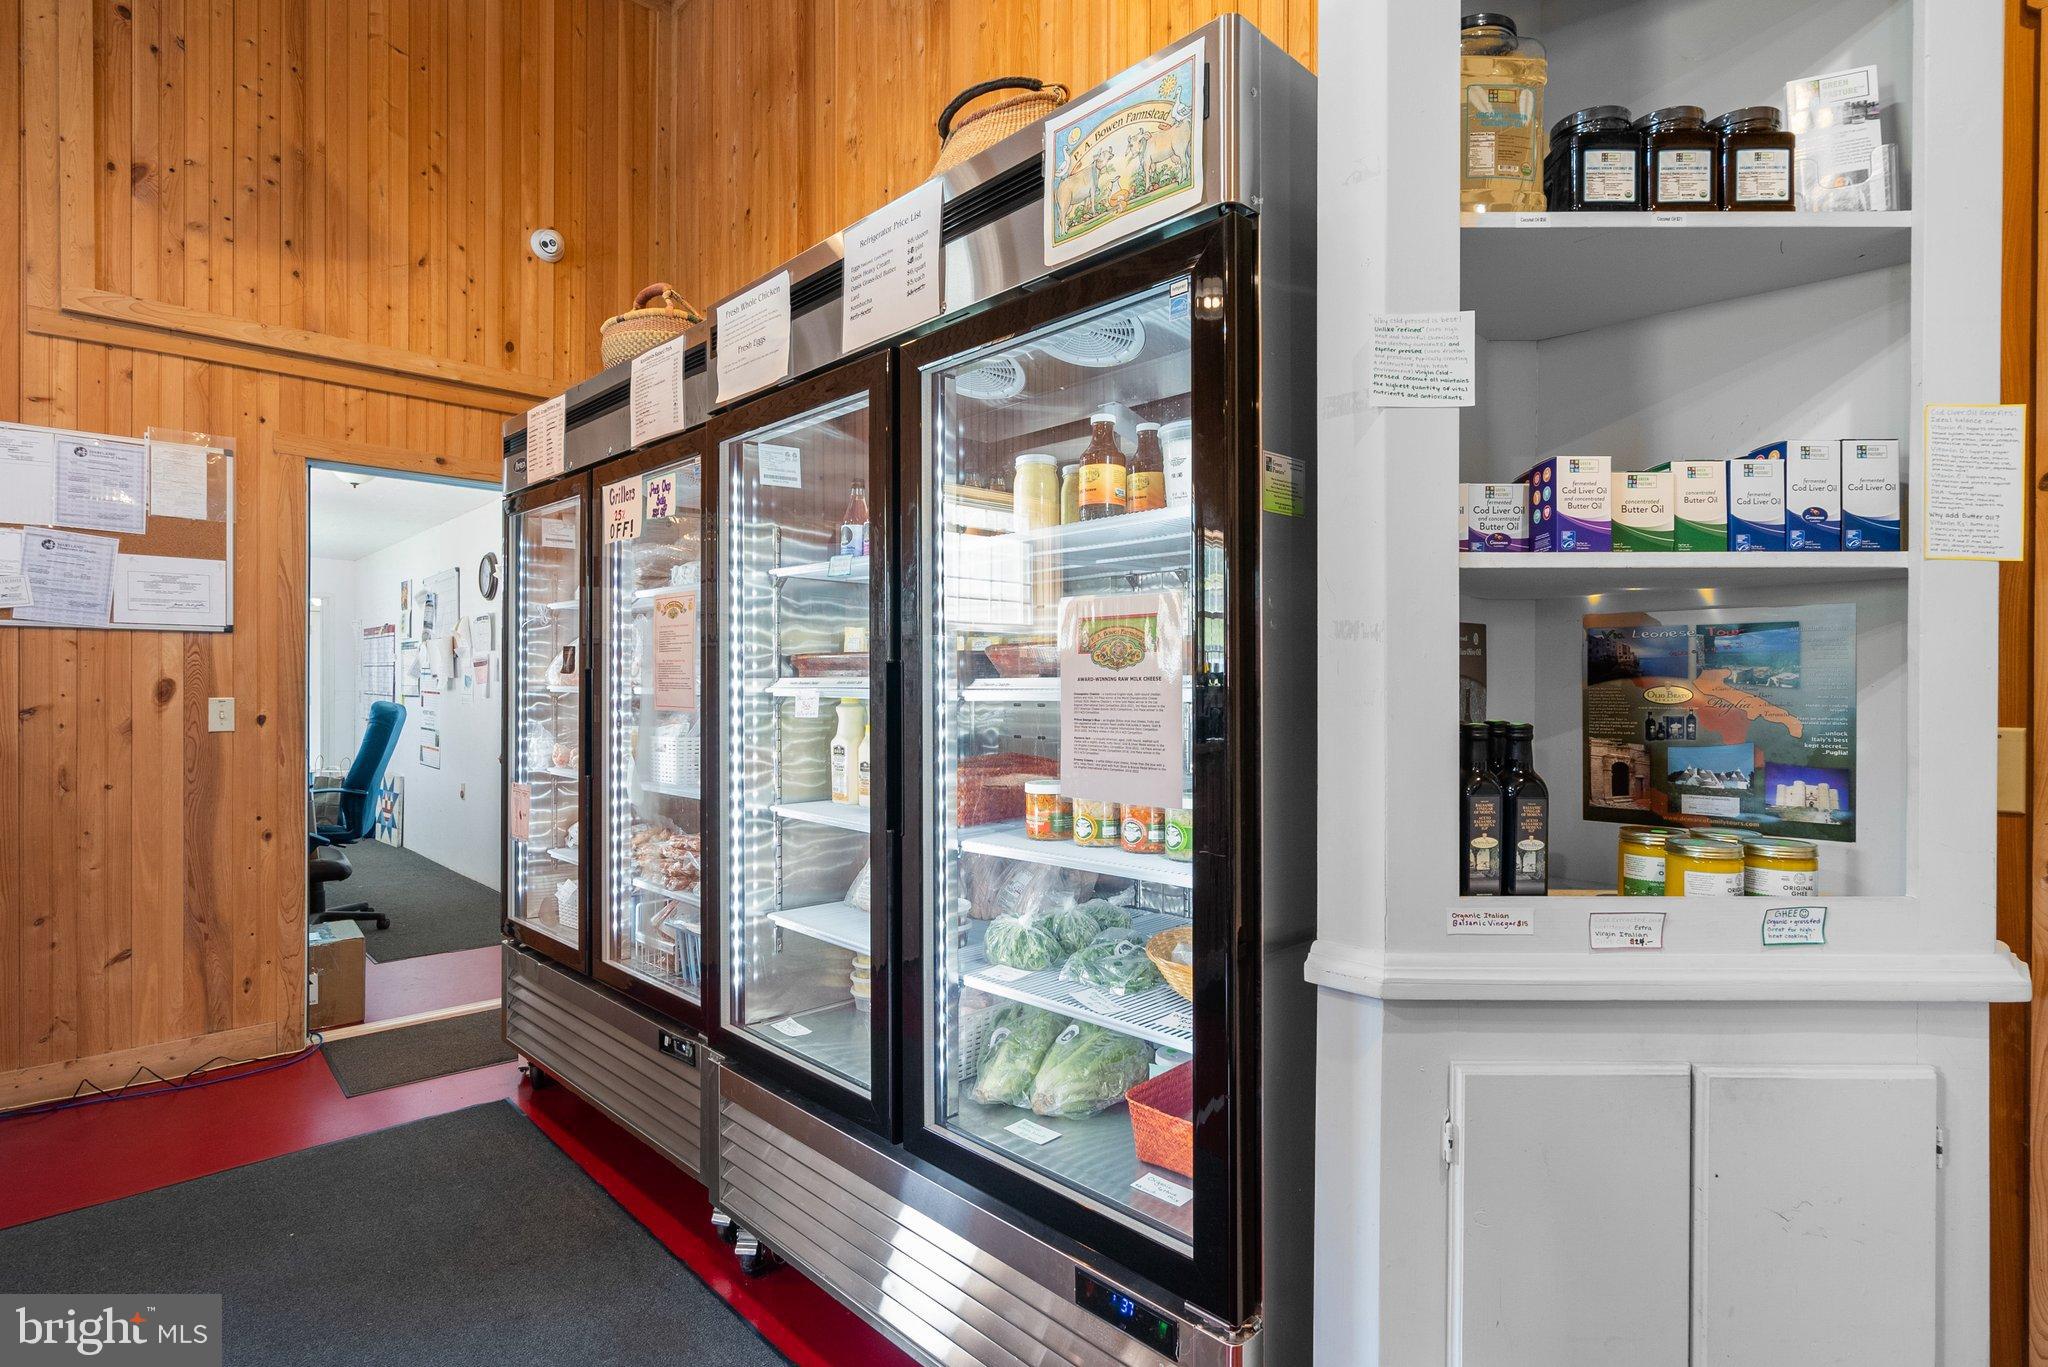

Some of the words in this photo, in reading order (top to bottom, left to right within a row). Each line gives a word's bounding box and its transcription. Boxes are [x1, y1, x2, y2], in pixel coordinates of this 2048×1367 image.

[1094, 117, 1124, 141] Bowen
[1125, 109, 1171, 124] Farmstead
[859, 223, 893, 248] Refrigerator
[893, 214, 909, 231] Price
[910, 209, 922, 222] List
[726, 305, 740, 319] Fresh
[741, 296, 757, 312] Whole
[758, 285, 781, 303] Chicken
[738, 341, 752, 355] Fresh
[753, 334, 766, 349] Eggs
[1373, 389, 1404, 397] nutrients
[1386, 382, 1409, 390] highest
[609, 486, 636, 506] Grillers
[1473, 506, 1490, 515] Cod
[1492, 506, 1511, 515] Liver
[1512, 506, 1525, 515] Oil
[1621, 505, 1648, 513] Butter
[1651, 505, 1664, 513] Oil
[610, 519, 634, 538] OFF!
[1479, 522, 1504, 530] Butter
[1506, 522, 1519, 530] Oil
[1631, 628, 1697, 640] Leonese
[1707, 627, 1743, 637] Tour
[1707, 698, 1752, 716] Puglia
[1452, 912, 1481, 921] Organic
[1488, 920, 1516, 929] Vinegar
[1120, 1298, 1134, 1317] 37
